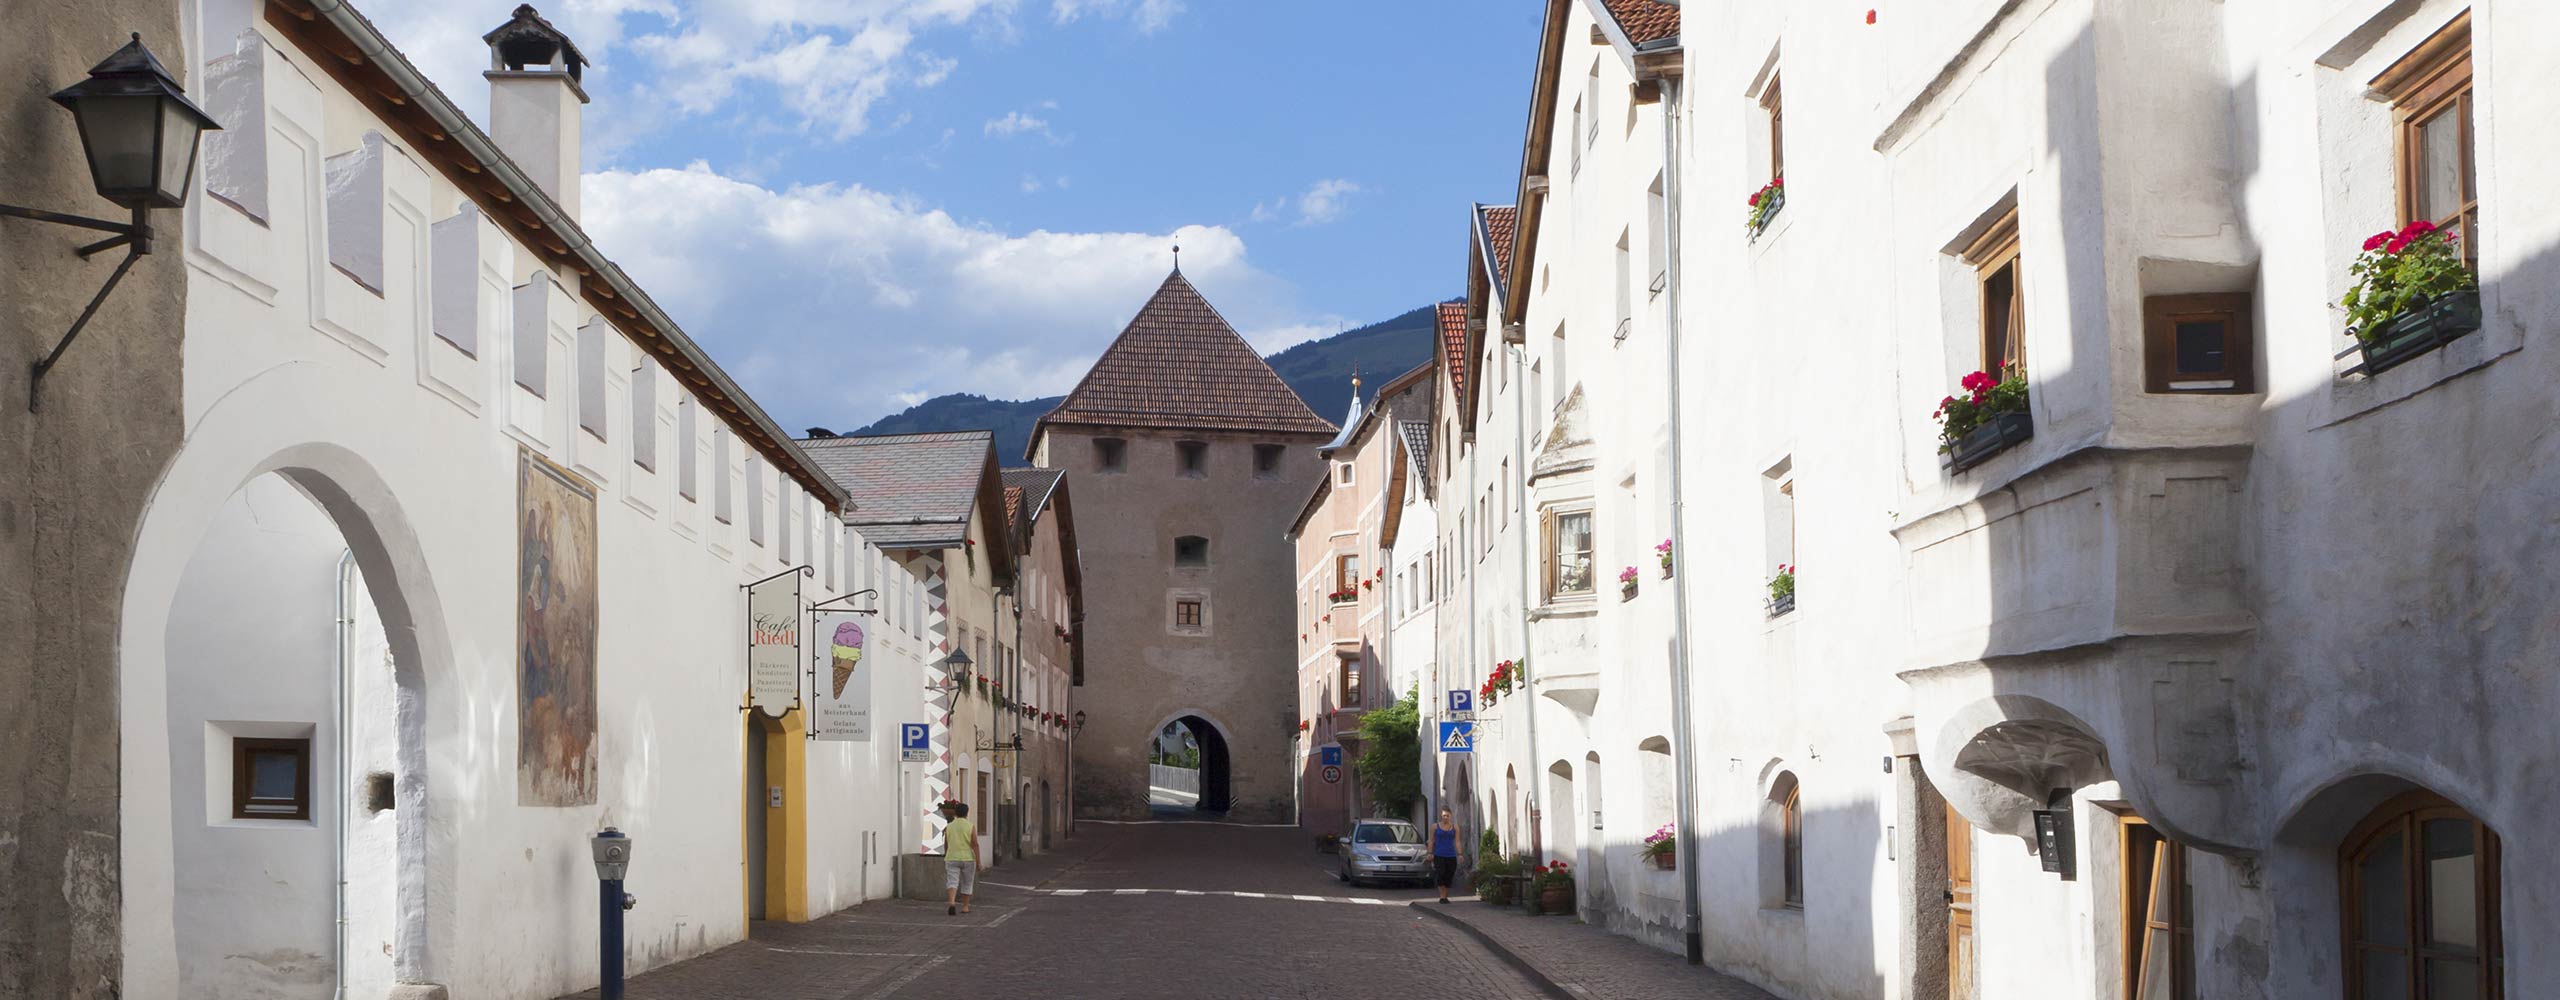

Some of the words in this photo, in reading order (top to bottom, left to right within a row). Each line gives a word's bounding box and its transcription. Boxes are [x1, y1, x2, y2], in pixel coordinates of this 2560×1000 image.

[753, 612, 796, 636] Café
[755, 629, 795, 645] Riedl
[1453, 692, 1467, 709] P
[907, 725, 924, 746] P
